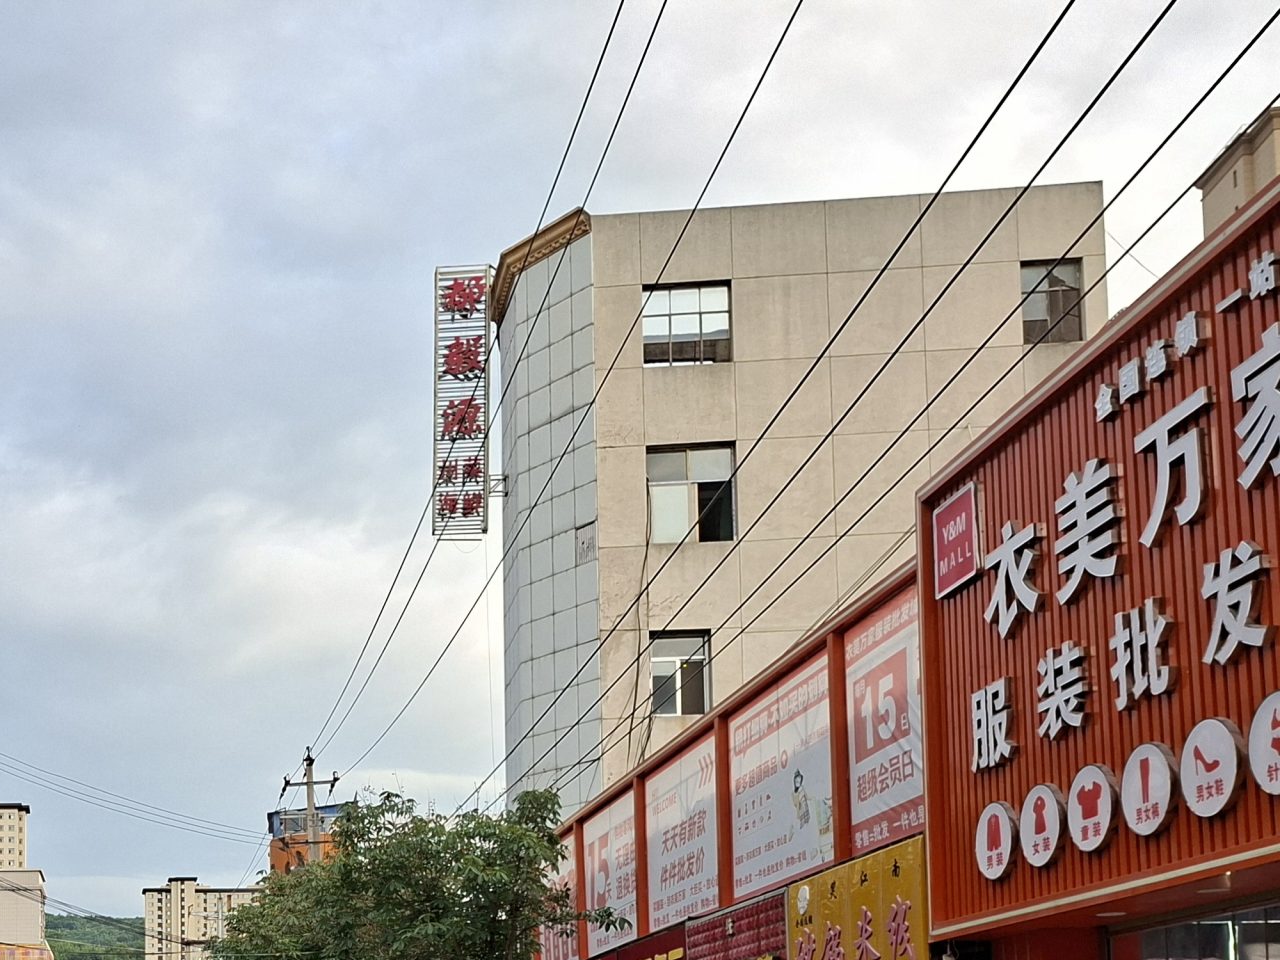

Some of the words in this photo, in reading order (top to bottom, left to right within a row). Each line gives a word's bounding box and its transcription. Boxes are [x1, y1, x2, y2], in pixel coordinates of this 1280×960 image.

[984, 322, 1280, 639] 衣美万家
[942, 512, 966, 544] Y&M
[940, 541, 971, 577] MALL
[971, 540, 1268, 773] 服装批发
[861, 673, 897, 750] 15
[901, 712, 910, 730] 日
[857, 749, 915, 802] 超级会员日
[1196, 777, 1225, 803] 男女鞋
[661, 808, 708, 857] 天天有新款
[1032, 839, 1051, 856] 女装
[1080, 822, 1103, 842] 童装
[588, 833, 610, 912] 15
[660, 846, 705, 891] 件件批发价
[986, 852, 1004, 871] 男装
